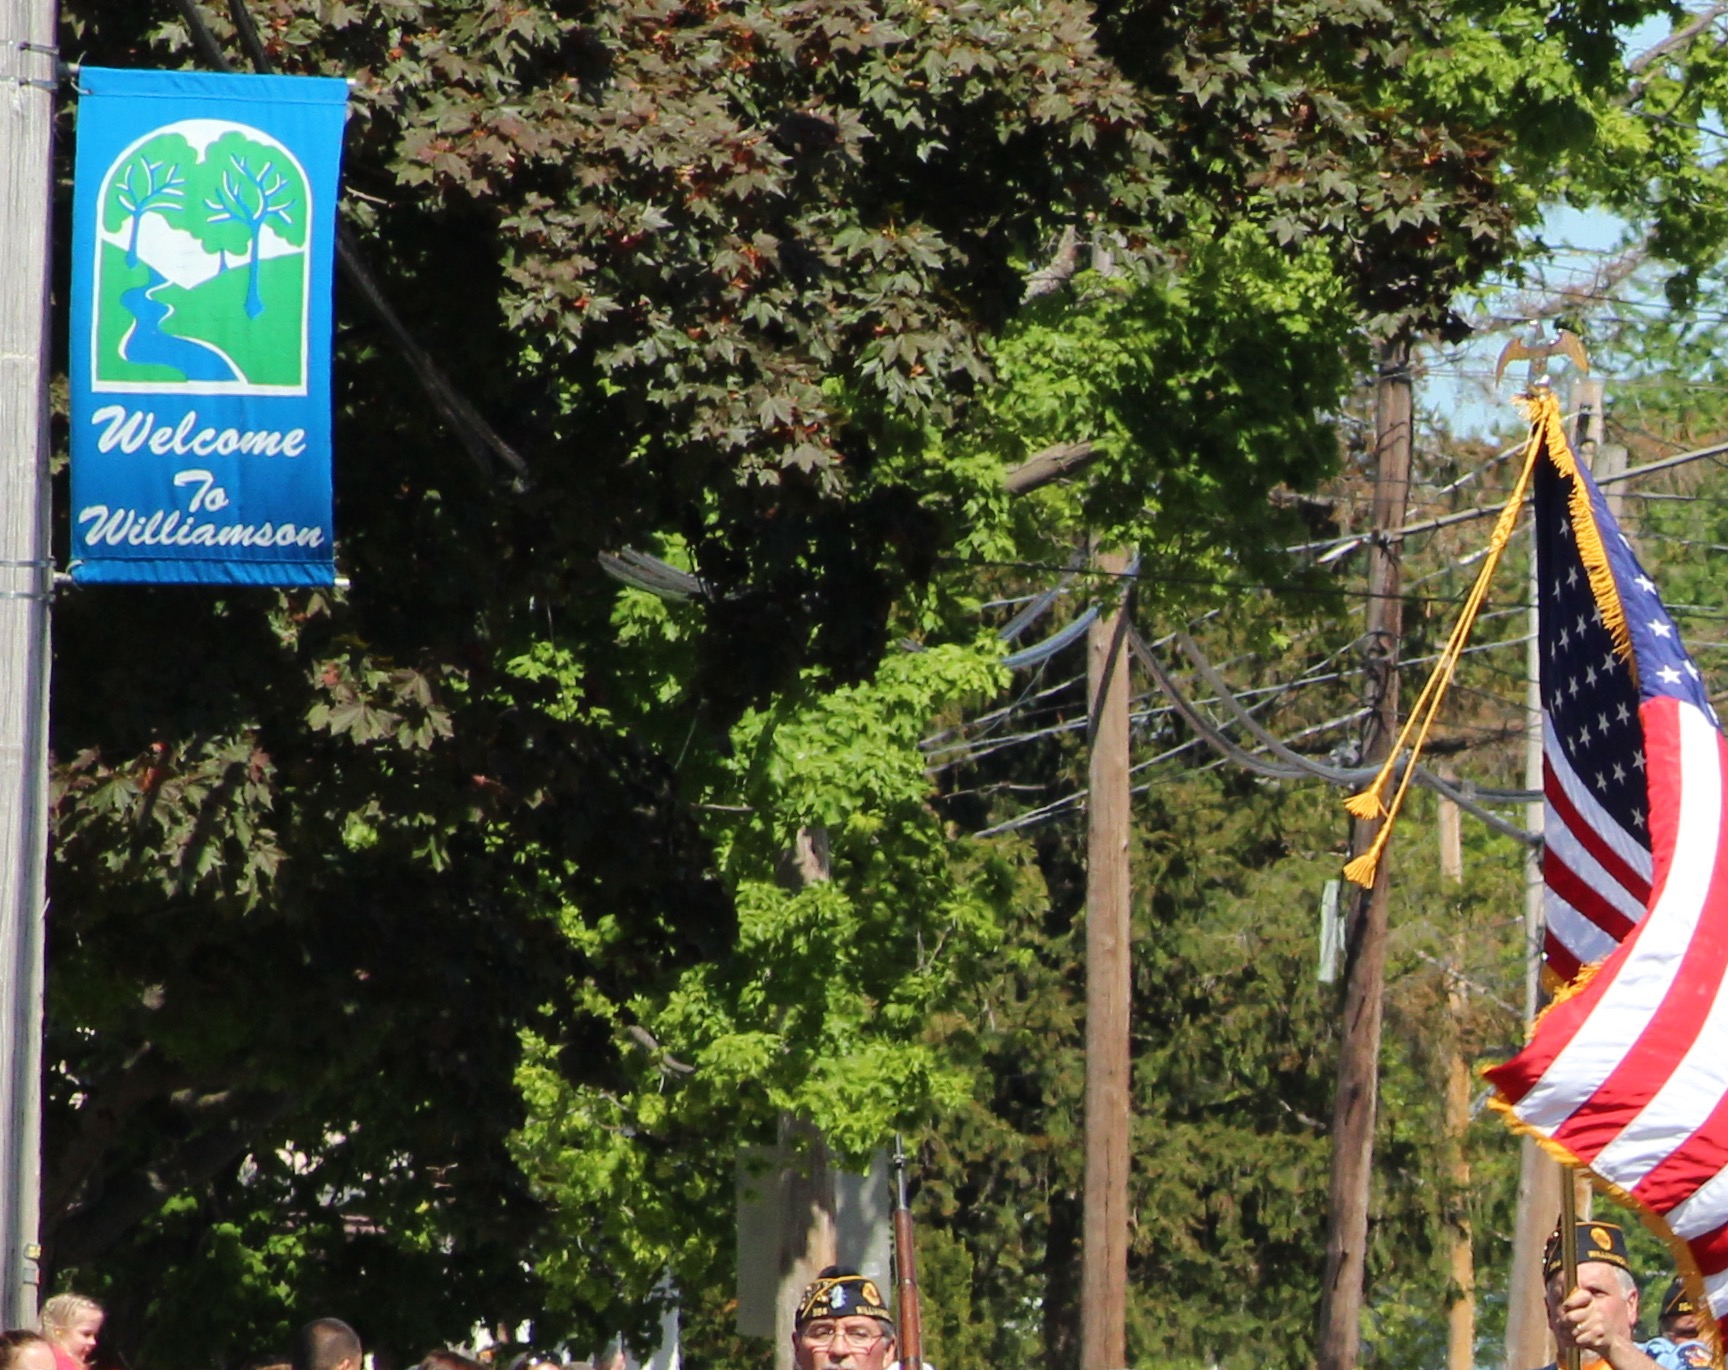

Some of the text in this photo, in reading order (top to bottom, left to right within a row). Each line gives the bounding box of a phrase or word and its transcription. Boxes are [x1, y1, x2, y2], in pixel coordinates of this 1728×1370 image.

[91, 405, 306, 457] Welcome
[174, 469, 229, 513] To
[79, 505, 324, 547] Williamson
